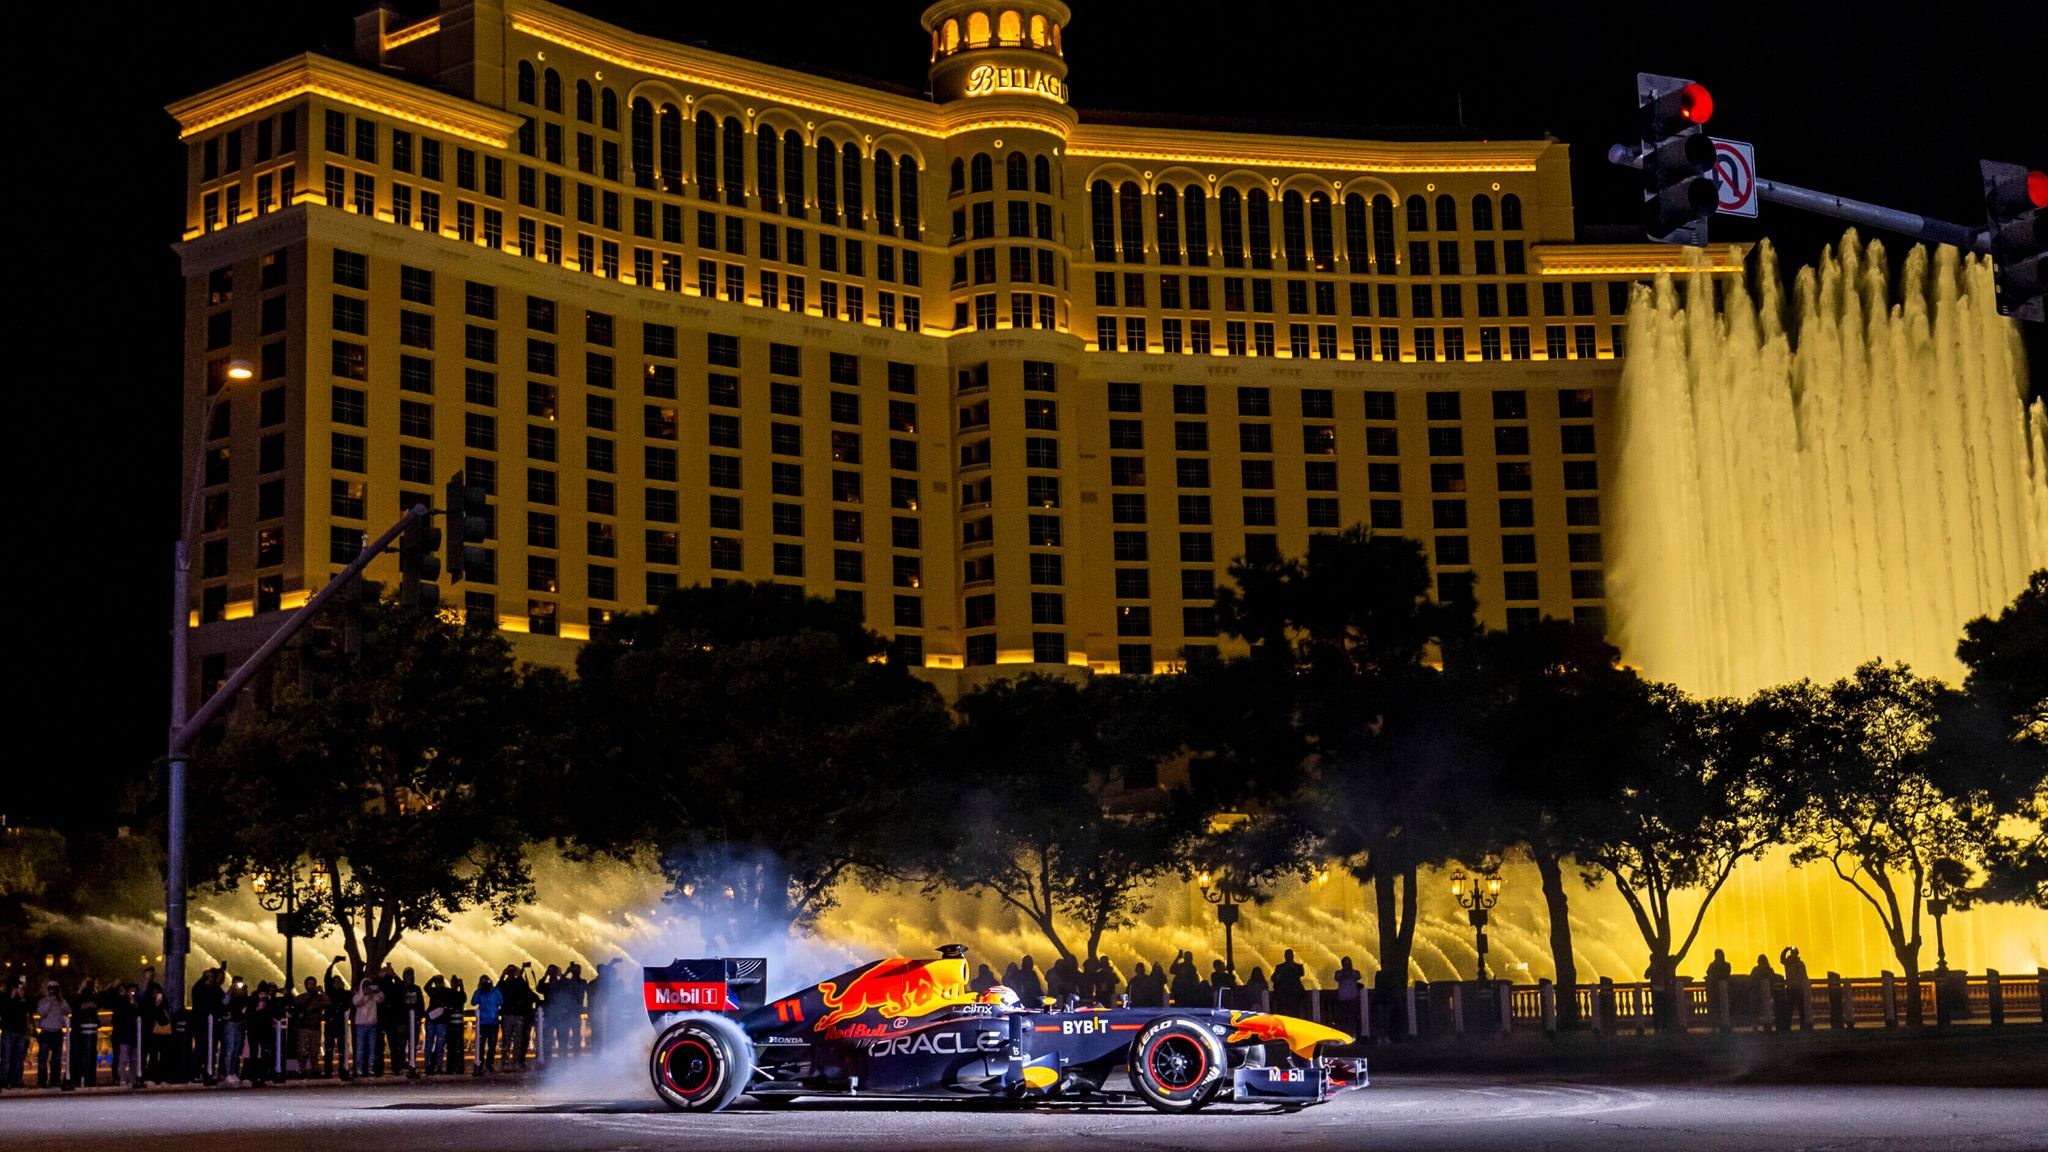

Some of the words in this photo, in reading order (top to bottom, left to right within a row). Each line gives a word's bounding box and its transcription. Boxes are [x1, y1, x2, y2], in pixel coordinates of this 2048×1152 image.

[656, 988, 700, 1004] Mobil
[773, 999, 804, 1022] 11
[962, 1003, 993, 1014] citrix
[825, 1023, 857, 1040] Red
[853, 1023, 888, 1037] Bull
[1062, 1015, 1109, 1035] BYBIT
[768, 1036, 803, 1044] HONDA
[868, 1031, 1001, 1058] ORACLE
[1137, 1020, 1172, 1057] ZERO
[1269, 1069, 1305, 1082] Mobil
